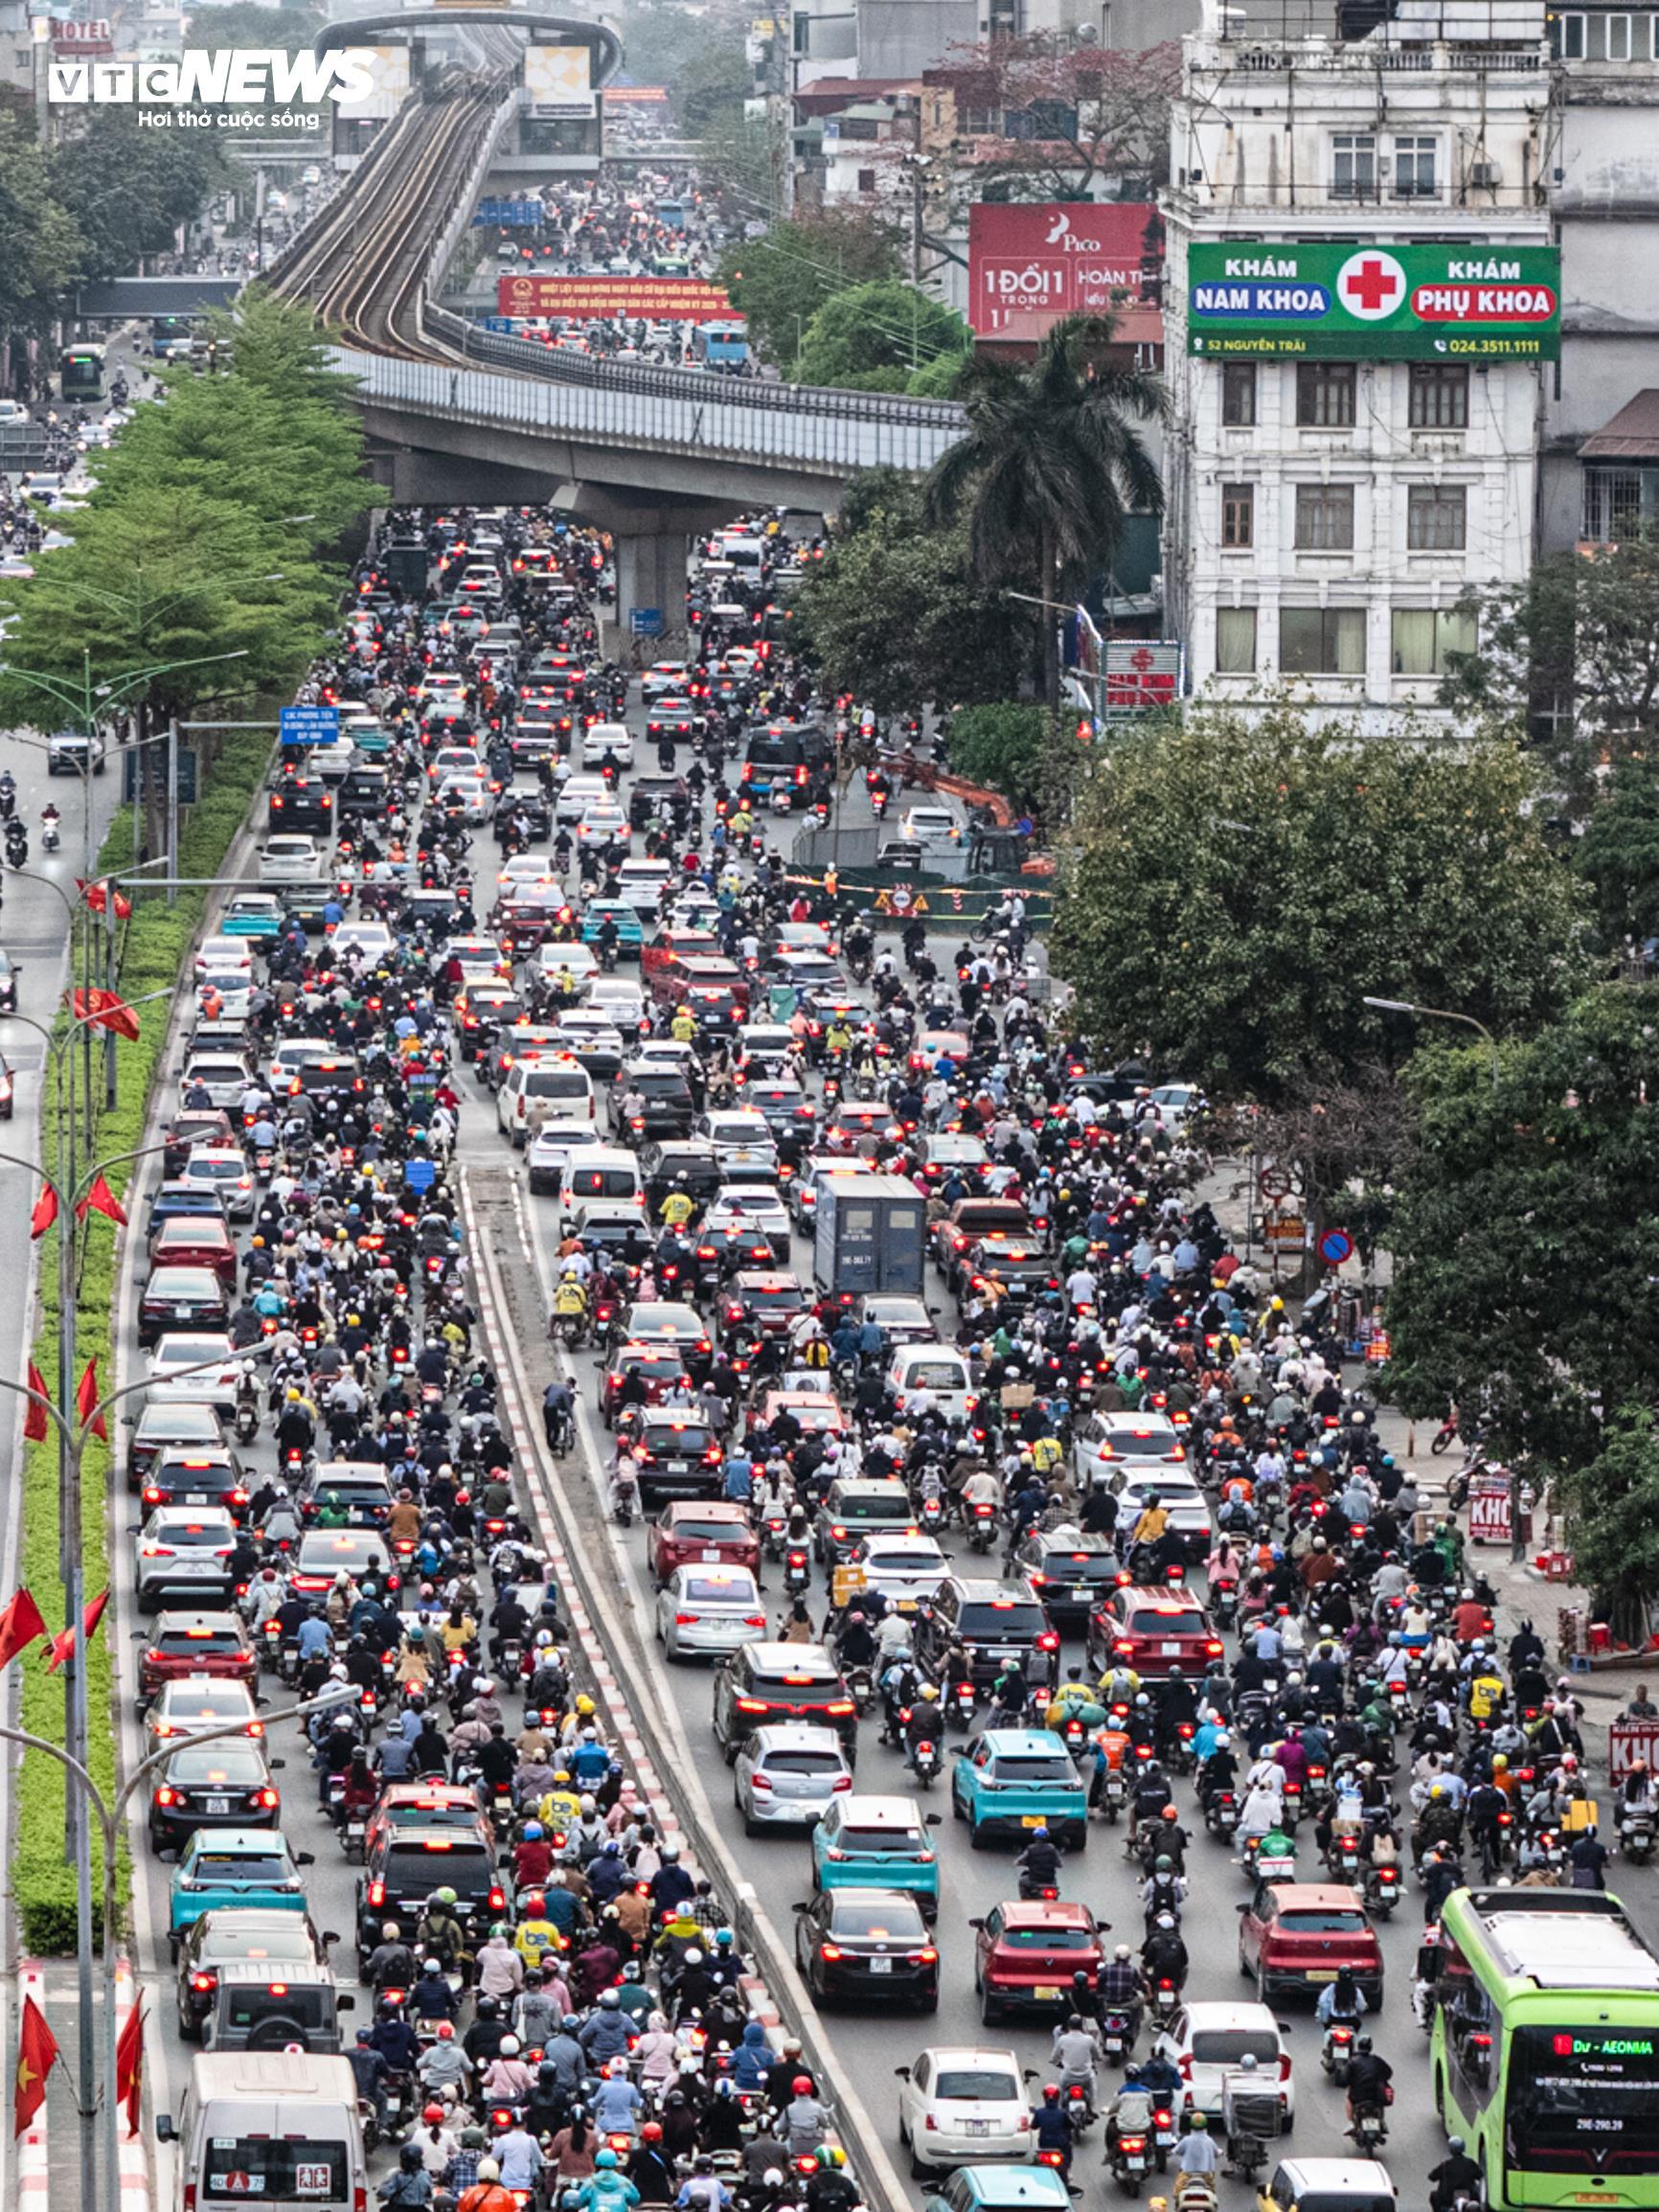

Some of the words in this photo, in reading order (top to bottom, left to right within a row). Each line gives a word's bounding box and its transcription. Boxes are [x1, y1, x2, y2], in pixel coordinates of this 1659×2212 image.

[55, 21, 109, 39] HOTEL
[1226, 255, 1297, 278] KHÁM
[1448, 257, 1520, 279] KHÁM
[1000, 295, 1048, 306] TRONG
[1196, 289, 1247, 310] NAM
[1257, 289, 1326, 311] KHOA
[1419, 290, 1470, 317] PHỤ
[1478, 291, 1550, 313] KHOA
[1208, 340, 1221, 352] 52
[1449, 339, 1540, 353] 024.3511.1111
[552, 1798, 572, 1814] be
[525, 1929, 548, 1947] be
